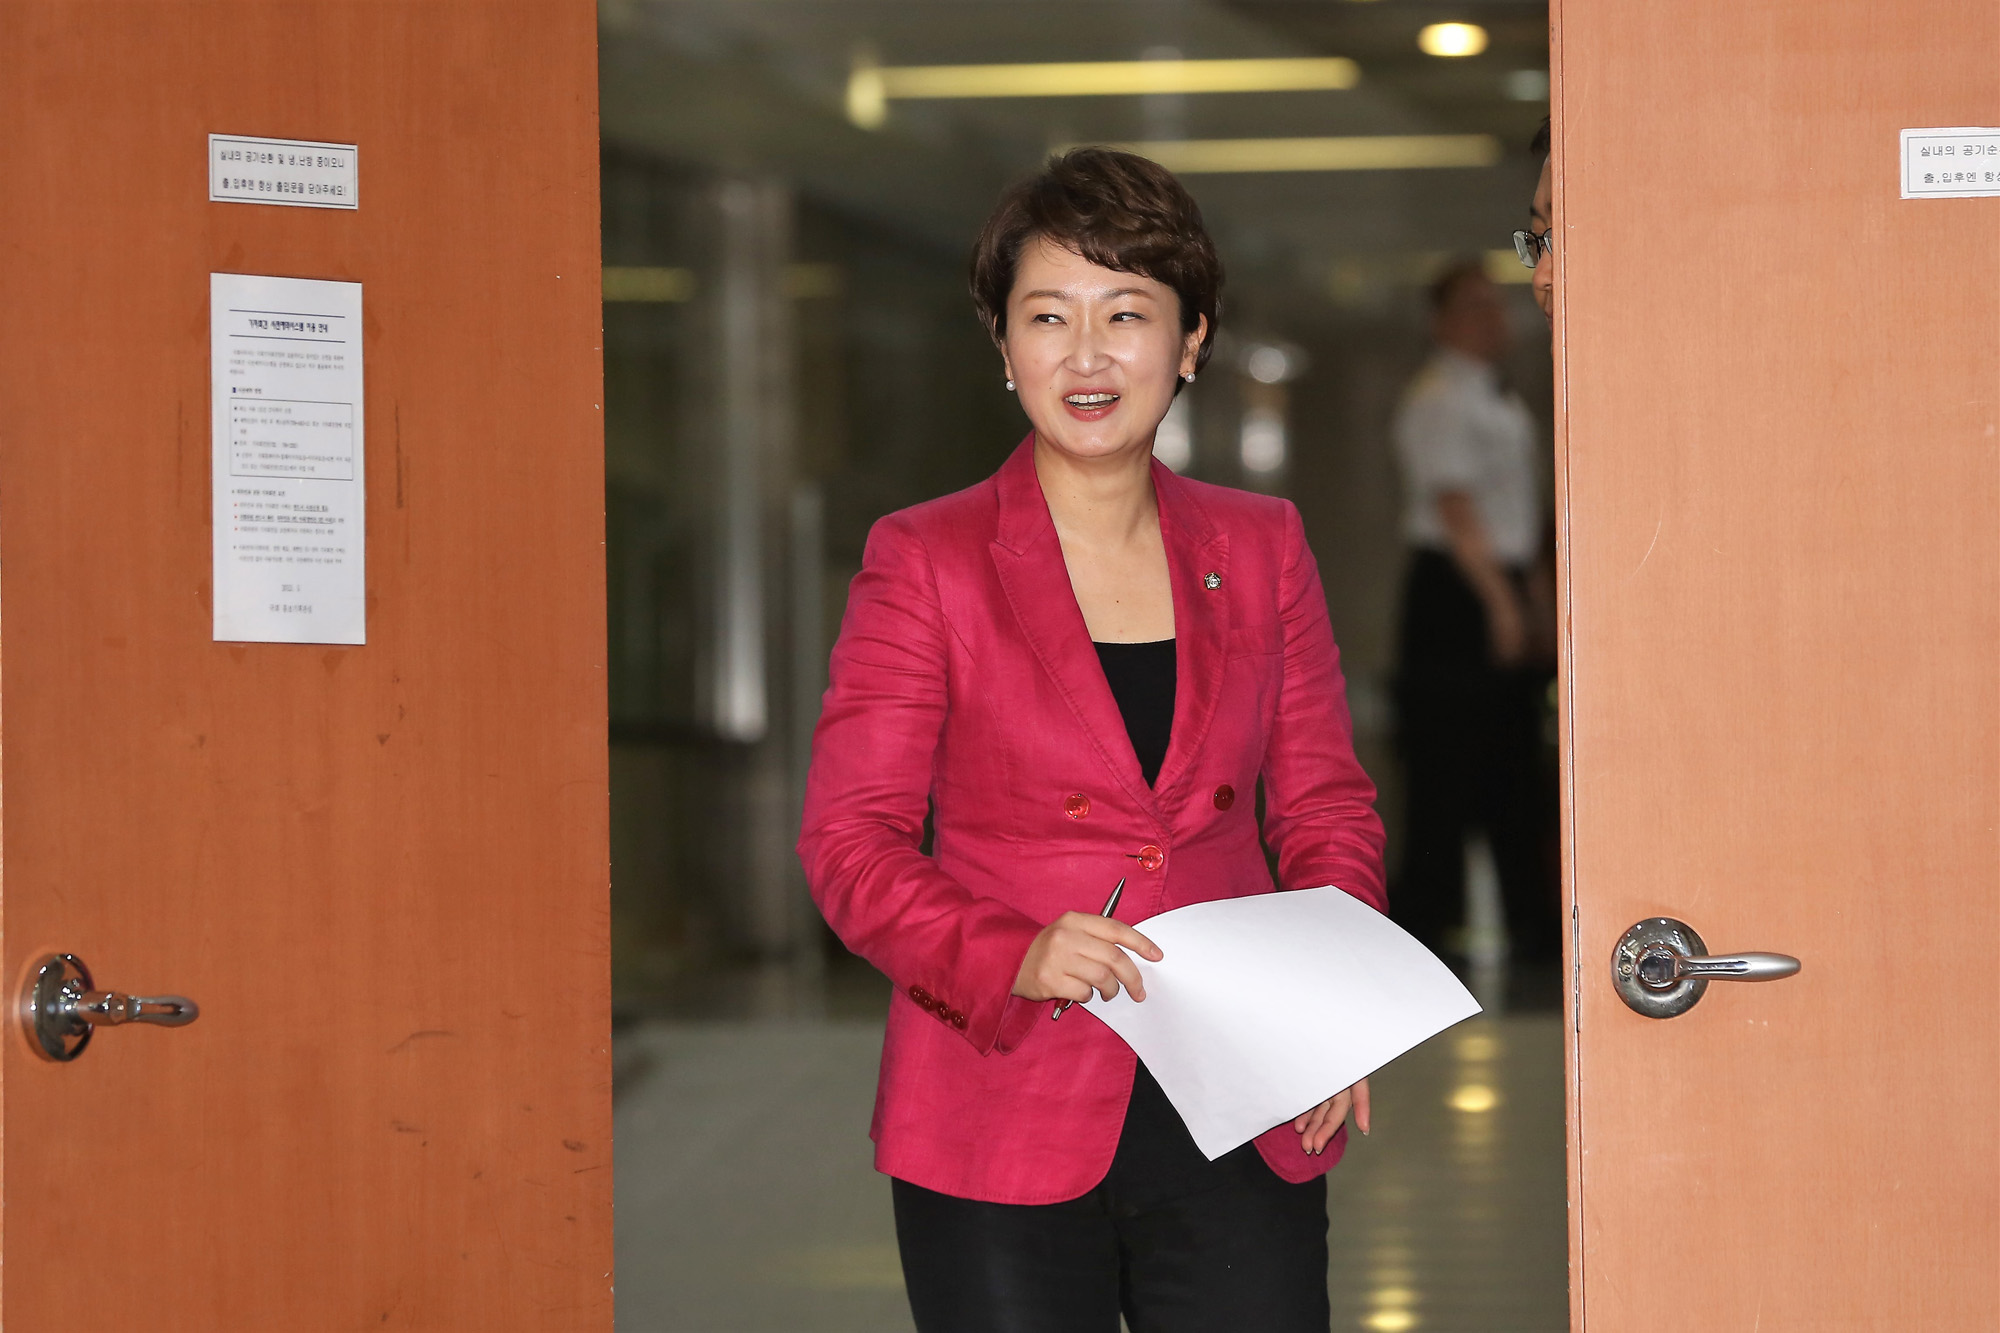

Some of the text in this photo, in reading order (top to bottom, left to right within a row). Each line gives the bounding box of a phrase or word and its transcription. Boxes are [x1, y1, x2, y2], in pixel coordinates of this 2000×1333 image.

[1920, 144, 2000, 157] 실내의 공기순
[220, 150, 241, 161] 실내의
[245, 151, 274, 164] 공기순환
[317, 156, 344, 168] 중이오니
[258, 179, 272, 192] 항상
[276, 181, 304, 194] 출입문을
